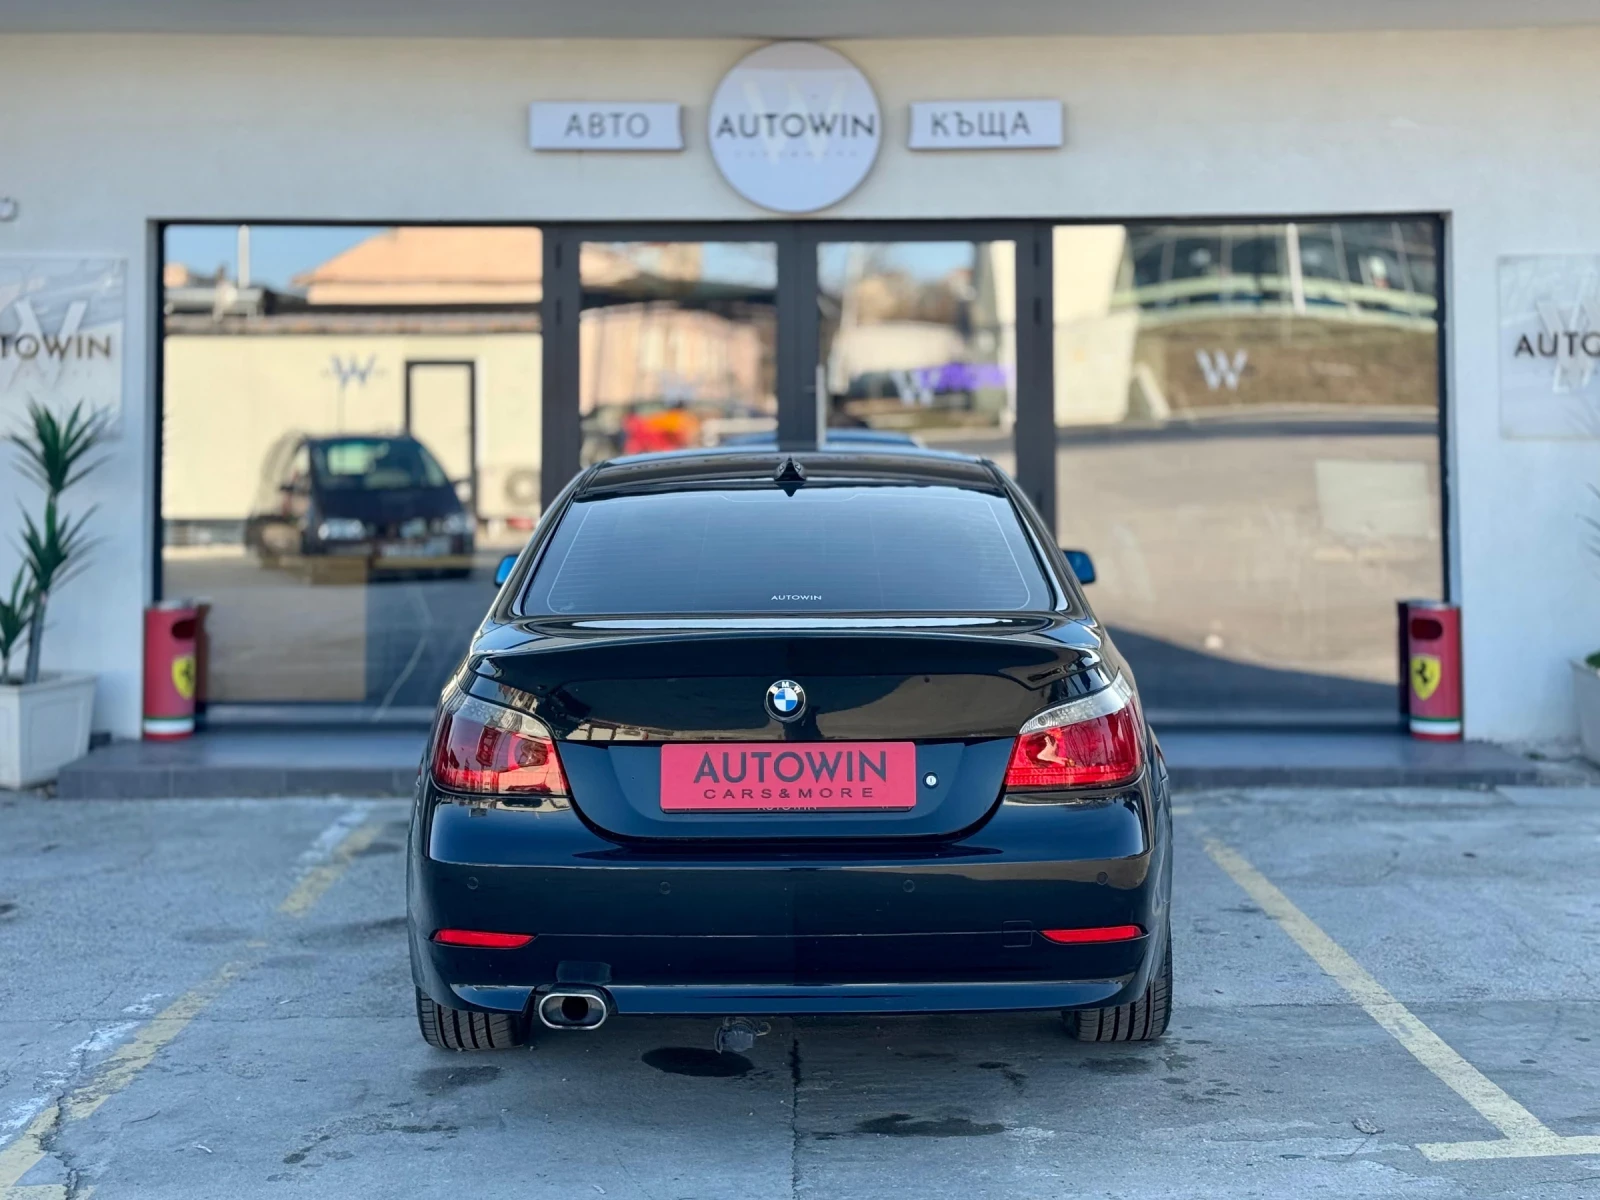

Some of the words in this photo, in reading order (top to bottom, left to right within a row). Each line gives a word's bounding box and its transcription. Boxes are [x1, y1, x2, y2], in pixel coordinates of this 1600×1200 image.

[564, 111, 651, 139] АВТО
[716, 112, 876, 139] AUTOWIN
[930, 110, 1033, 143] КЪЩА
[1195, 347, 1249, 392] W
[769, 681, 802, 694] BMW
[693, 750, 888, 784] AUTOWIN
[703, 786, 874, 800] CARS&MORE
